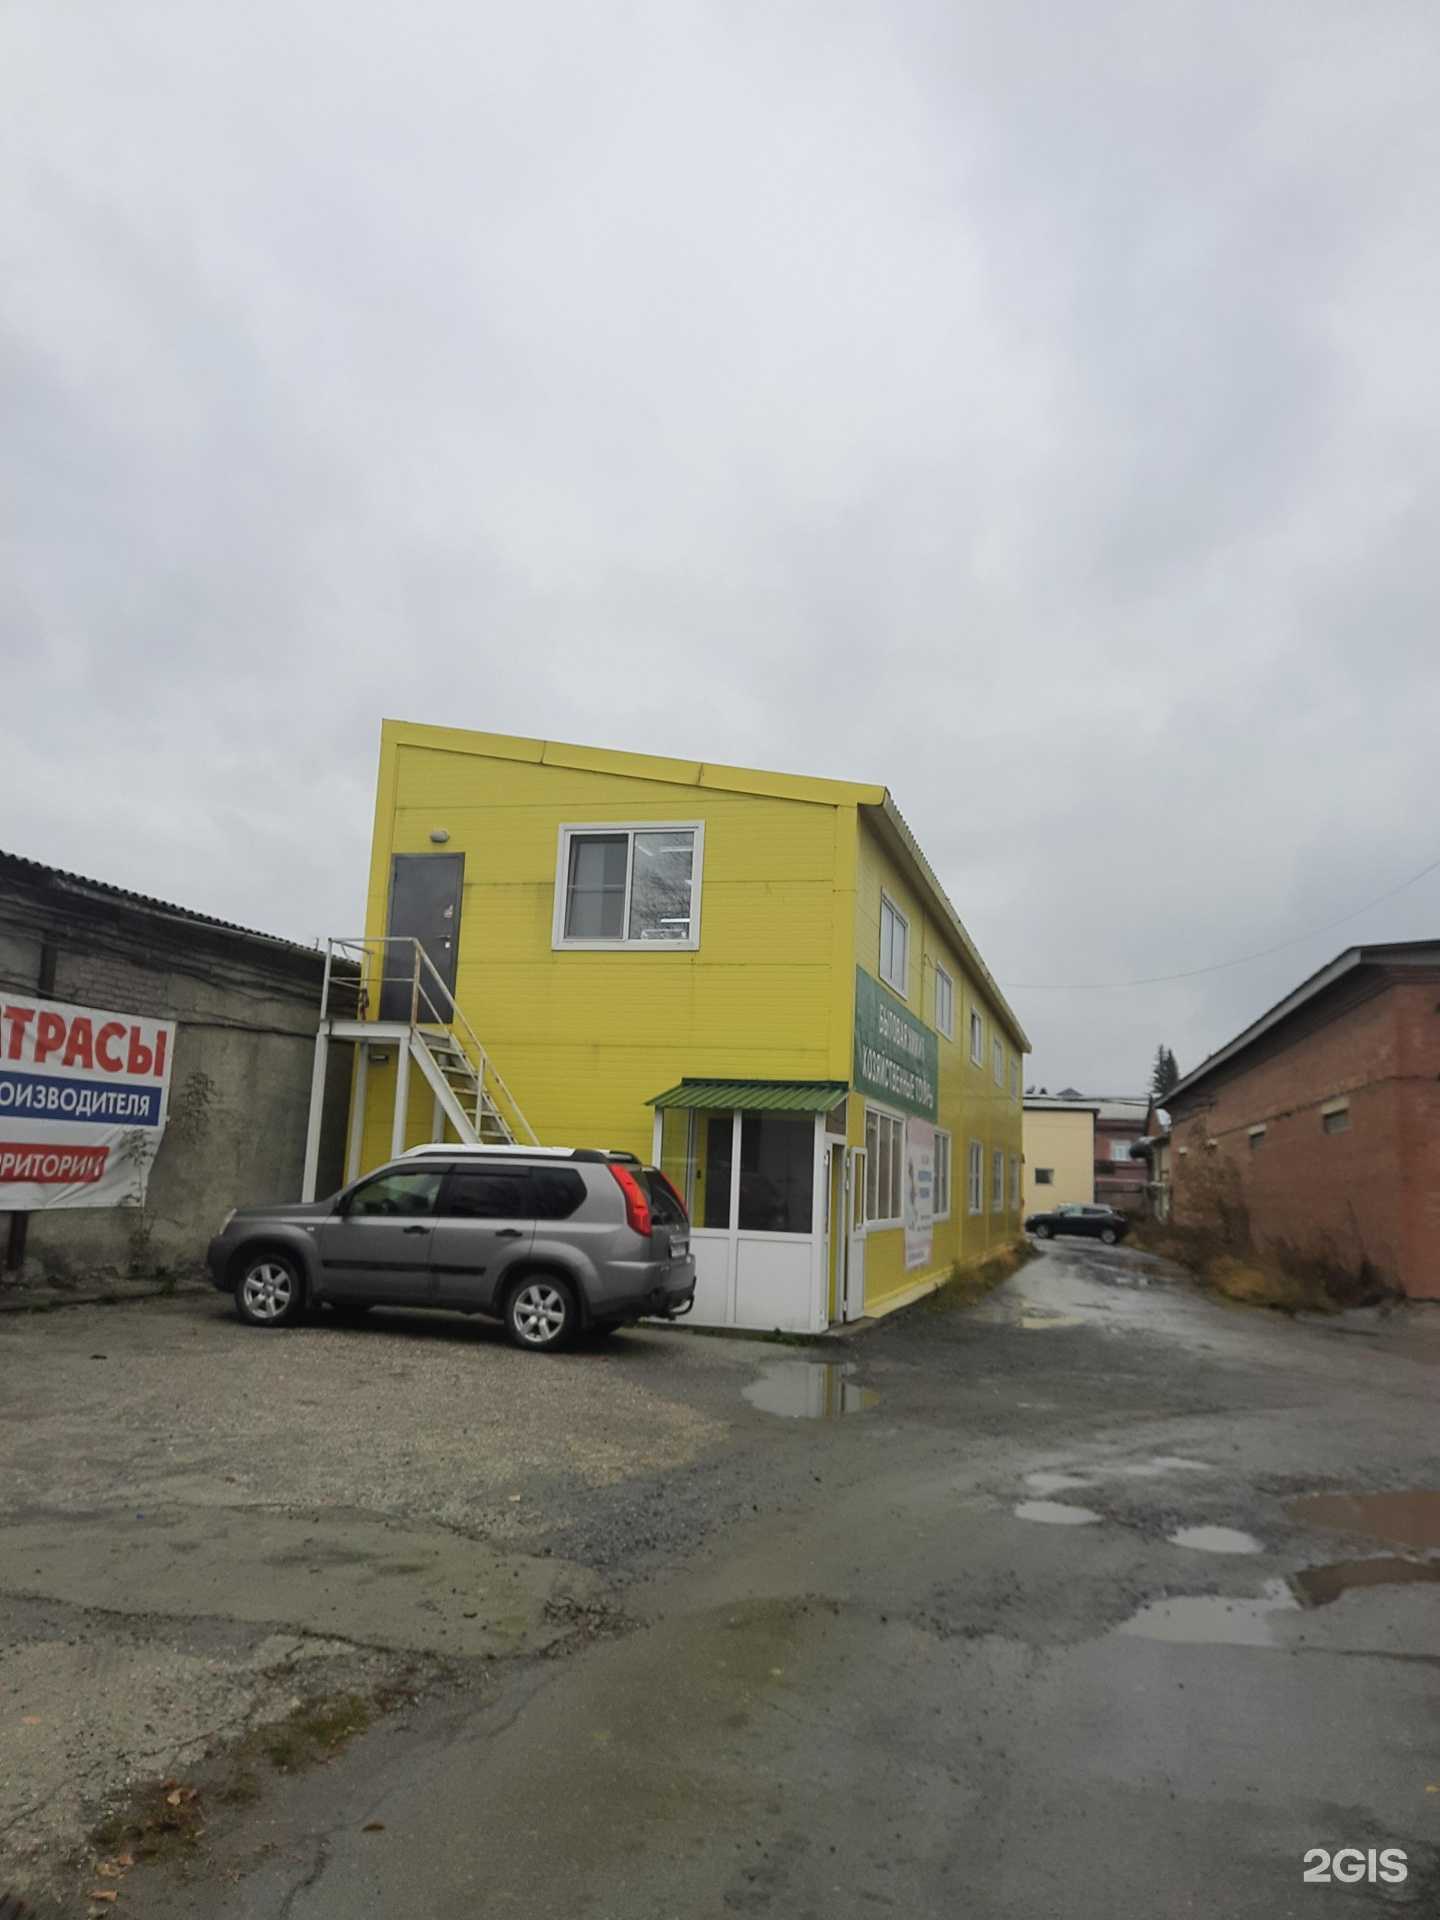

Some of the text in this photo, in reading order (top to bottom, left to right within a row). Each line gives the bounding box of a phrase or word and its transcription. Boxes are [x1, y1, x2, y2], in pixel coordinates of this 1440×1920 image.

[0, 1005, 167, 1077] ТРАСЫ
[0, 1082, 151, 1117] ОИЗВОДИТЕЛЯ
[0, 1153, 104, 1177] РИТОРИИ
